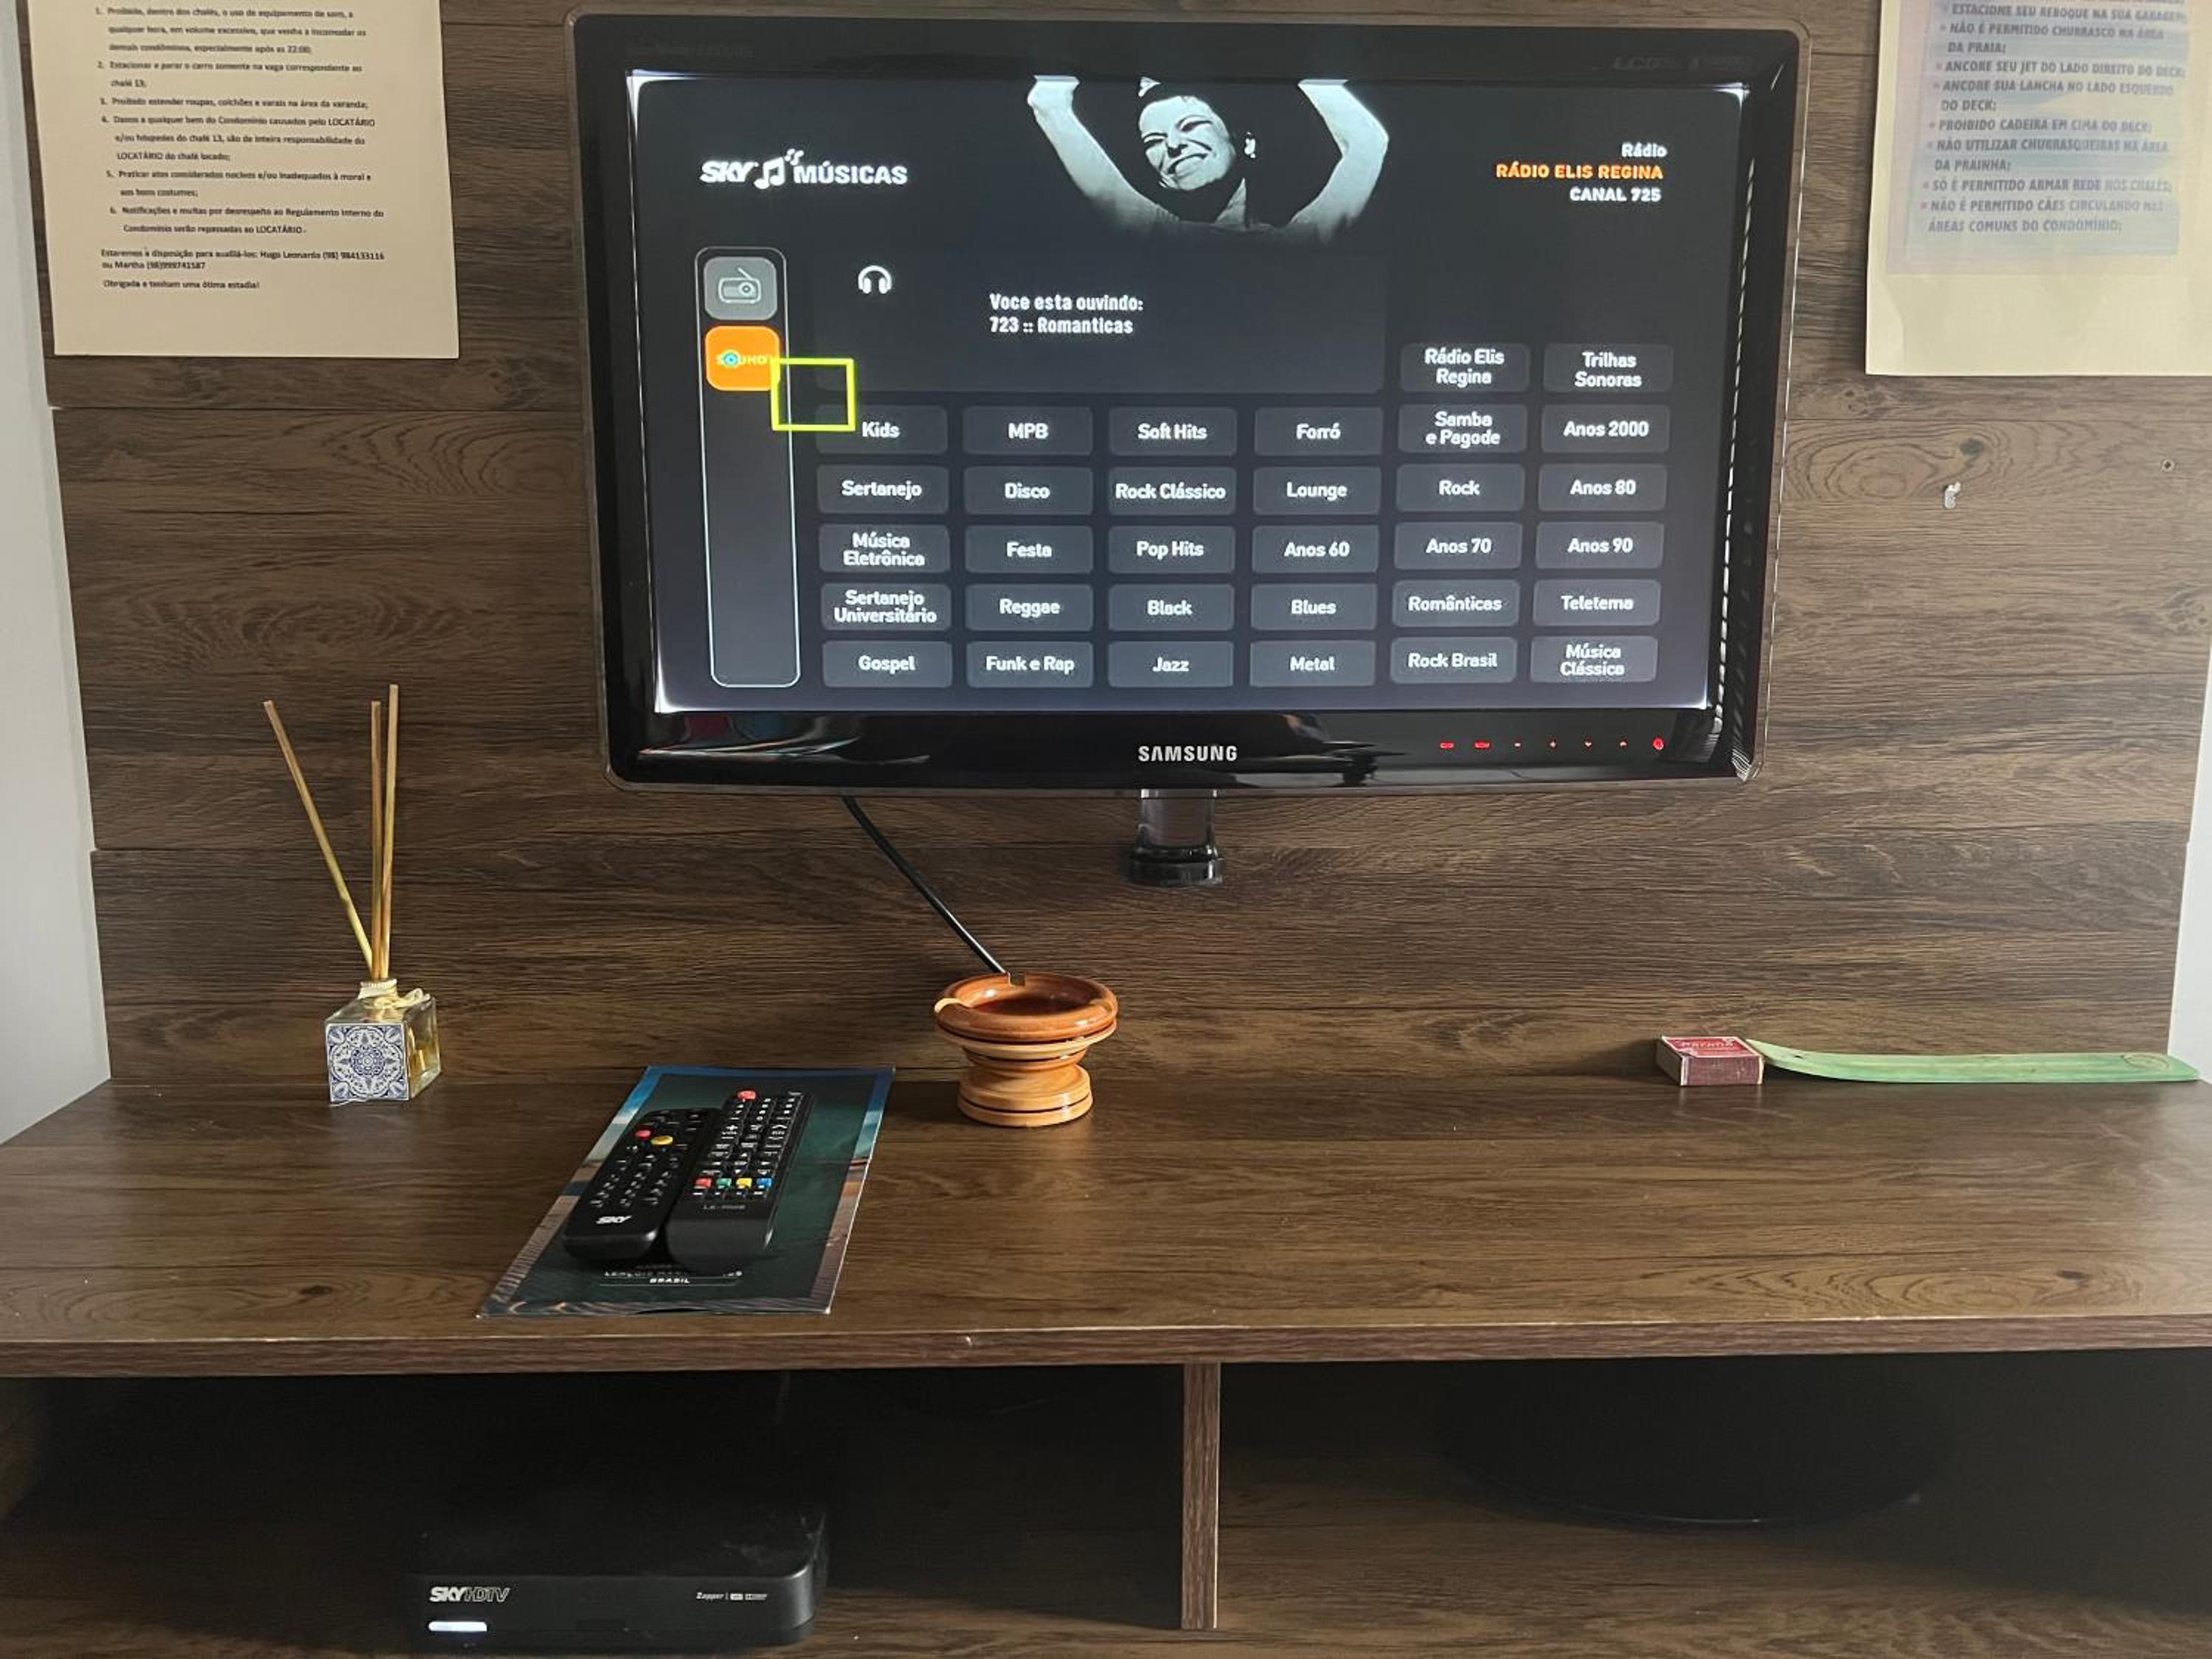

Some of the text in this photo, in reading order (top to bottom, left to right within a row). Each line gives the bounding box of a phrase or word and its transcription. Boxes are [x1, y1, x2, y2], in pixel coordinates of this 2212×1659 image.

[1621, 142, 1668, 157] Rádio
[700, 160, 908, 184] SKY MÚSICAS
[1496, 161, 1663, 179] RÁDIO ELIS REGINA
[1570, 187, 1661, 202] CANAL 725
[990, 293, 1144, 310] Voce esta ouvindo:
[990, 316, 1019, 333] 723
[1037, 316, 1133, 334] Romanticas
[1425, 348, 1505, 365] Rádio Elis
[1582, 352, 1637, 368] Trilhas
[1436, 369, 1492, 388] Regina
[1574, 372, 1642, 388] Sonoras
[1434, 411, 1492, 427] Samba
[861, 422, 900, 438] Kids
[1008, 422, 1049, 439] MPB
[1138, 422, 1207, 439] Soft Hits
[1296, 423, 1341, 439] Forró
[1563, 421, 1649, 437] Anos 2000
[1425, 429, 1500, 448] e Pagode
[841, 480, 922, 501] Sertanejo
[1004, 483, 1051, 499] Disco
[1116, 481, 1226, 499] Rock Clássico
[1287, 481, 1347, 501] Lounge
[1439, 480, 1480, 495] Rock
[1570, 479, 1636, 495] Anos 80
[852, 532, 911, 549] Música
[1426, 538, 1492, 554] Anos 70
[1568, 538, 1633, 554] Anos 90
[843, 549, 925, 567] Eletrônica
[1006, 541, 1052, 558] Festa
[1136, 540, 1204, 560] Pop Hits
[1284, 542, 1350, 557] Anos 60
[845, 590, 925, 610] Sertanejo
[999, 599, 1060, 618] Reggae
[1147, 599, 1193, 616] Black
[1291, 599, 1337, 616] Blues
[1408, 595, 1502, 612] Românticas
[1561, 595, 1634, 611] Teletema
[834, 606, 937, 623] Universitário
[1565, 643, 1621, 659] Música
[858, 655, 915, 674] Gospel
[986, 655, 1074, 675] Funk e Rap
[1152, 657, 1190, 672] Jazz
[1290, 657, 1335, 672] Metal
[1408, 653, 1498, 668] Rock Brasil
[1560, 660, 1625, 676] Clássica
[1138, 745, 1237, 762] SAMSUNG
[596, 1216, 632, 1225] SKY
